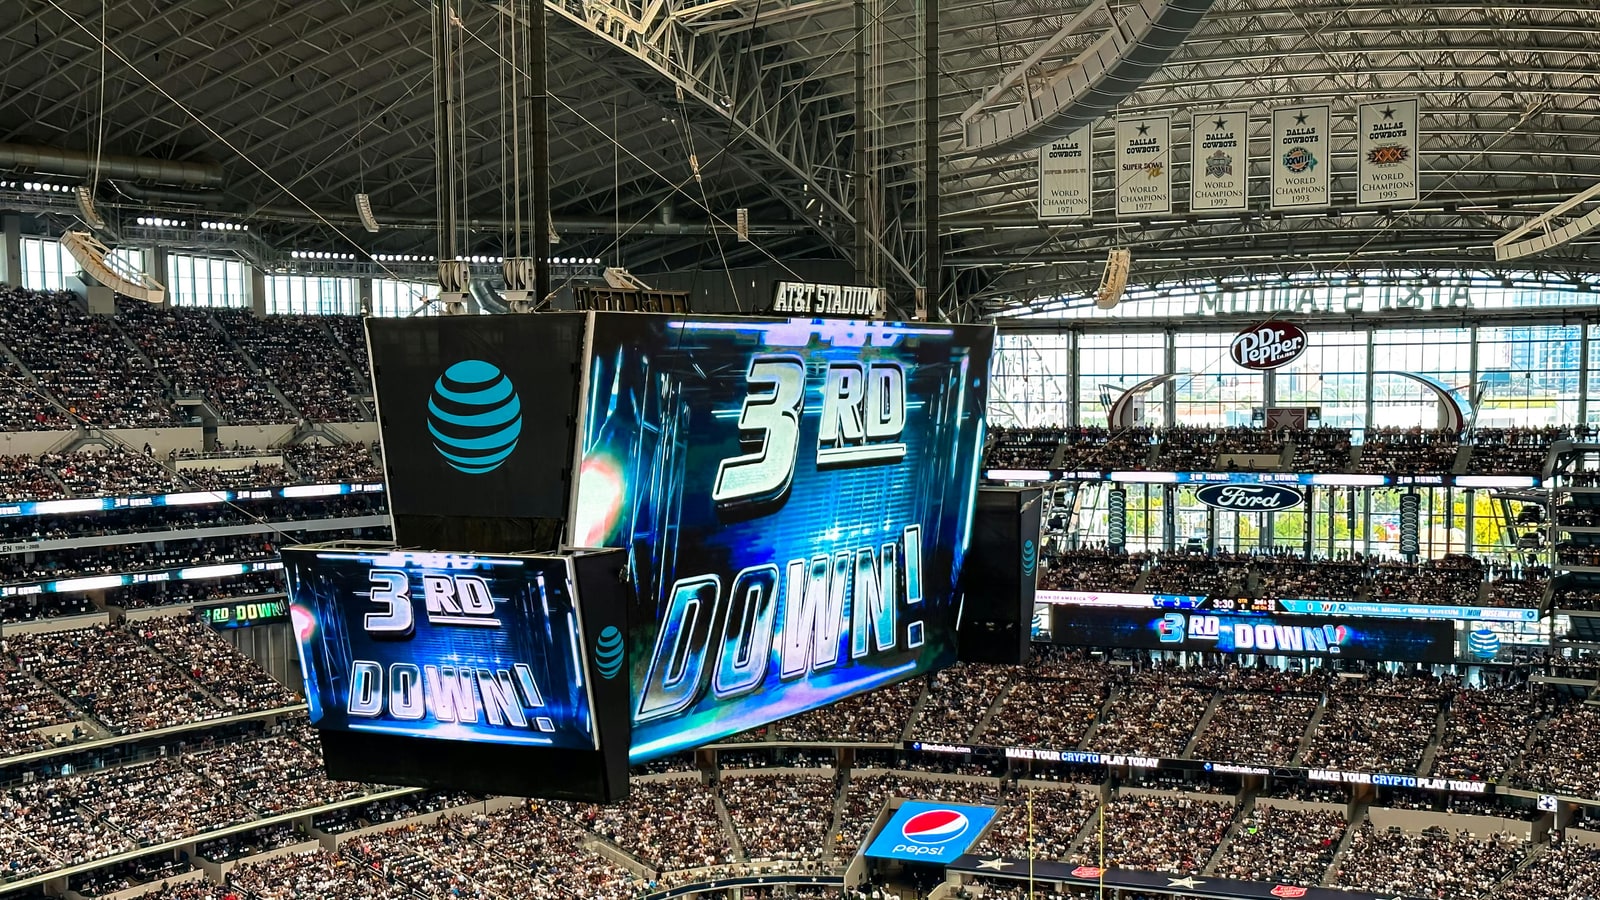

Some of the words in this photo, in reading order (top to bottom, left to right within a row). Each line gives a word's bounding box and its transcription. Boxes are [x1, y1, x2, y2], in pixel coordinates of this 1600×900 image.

[1373, 122, 1403, 131] DALLAS
[1206, 132, 1234, 140] DALLAS
[1286, 128, 1315, 136] DALLAS
[1369, 130, 1406, 140] COWBOYS
[1130, 138, 1156, 146] DALLAS
[1202, 140, 1237, 148] COWBOYS
[1282, 136, 1318, 144] COWBOYS
[1049, 150, 1082, 158] COWBOYS
[1126, 146, 1160, 154] COWBOYS
[1122, 162, 1142, 171] SUPER
[1129, 186, 1158, 194] WORLD
[1276, 186, 1325, 195] CHAMPIONS
[1362, 181, 1414, 191] CHAMPIONS
[1120, 194, 1166, 202] CHAMPIONS
[1195, 190, 1242, 198] CHAMPIONS
[1379, 191, 1398, 199] 1995
[1043, 198, 1088, 206] CHAMPIONS
[1292, 195, 1310, 203] 1993
[1057, 206, 1073, 214] 1971
[773, 281, 815, 312] AT&T
[816, 284, 879, 315] STADIUM
[1258, 328, 1285, 347] Dr
[1232, 332, 1301, 364] Pepper
[1217, 486, 1280, 507] Ford
[1174, 598, 1180, 606] 3
[1212, 599, 1234, 609] 3:30
[1307, 602, 1313, 611] 0
[633, 523, 925, 722] DOWN!
[1234, 624, 1341, 654] DOWN!
[347, 660, 556, 733] DOWN!
[921, 743, 971, 753] Blockchain.com
[1005, 748, 1034, 758] MAKE
[1035, 750, 1060, 760] YOUR
[1061, 752, 1099, 763] CRYPTO
[1100, 754, 1126, 765] PLAY
[1127, 756, 1159, 768] TODAY
[1213, 764, 1269, 775] Blockchain.com
[1308, 770, 1340, 781] MAKE
[1341, 772, 1371, 783] YOUR
[1372, 775, 1416, 787] CRYPTO
[1417, 778, 1447, 790] PLAY
[1448, 781, 1486, 792] TODAY
[892, 844, 945, 856] pepsi
